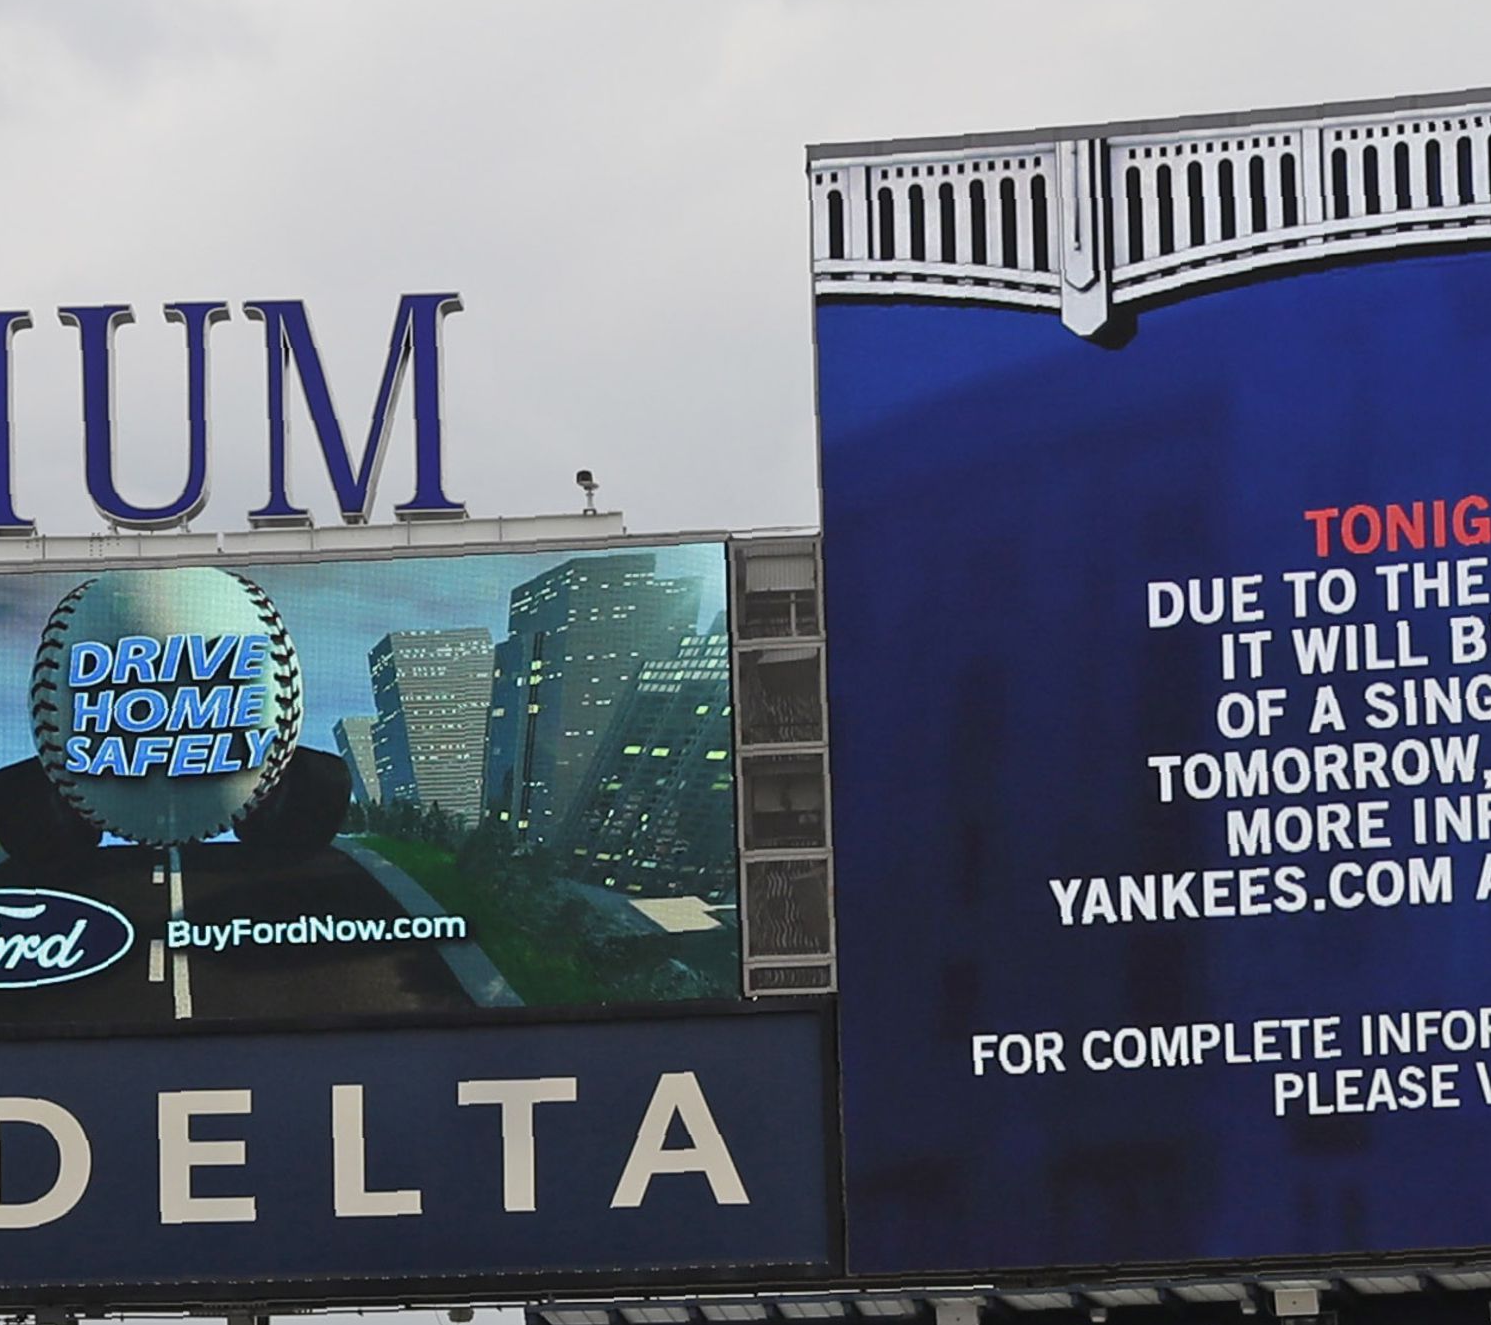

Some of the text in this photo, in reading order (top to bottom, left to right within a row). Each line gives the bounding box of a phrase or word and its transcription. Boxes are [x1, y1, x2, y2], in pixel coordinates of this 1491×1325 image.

[1148, 575, 1263, 627] DUE
[1284, 569, 1356, 617] TO
[1376, 558, 1489, 610] THE
[69, 633, 270, 686] DRIVE
[72, 685, 267, 734] HOME
[1218, 689, 1286, 738] OF
[1310, 686, 1345, 733] A
[65, 730, 276, 777] SAFELY
[1050, 857, 1452, 924] YANKEES.COM
[168, 915, 465, 951] BuyFordNow.com
[973, 1032, 1065, 1075] FOR
[1083, 1017, 1341, 1070] COMPLETE
[1275, 1065, 1459, 1115] PLEASE
